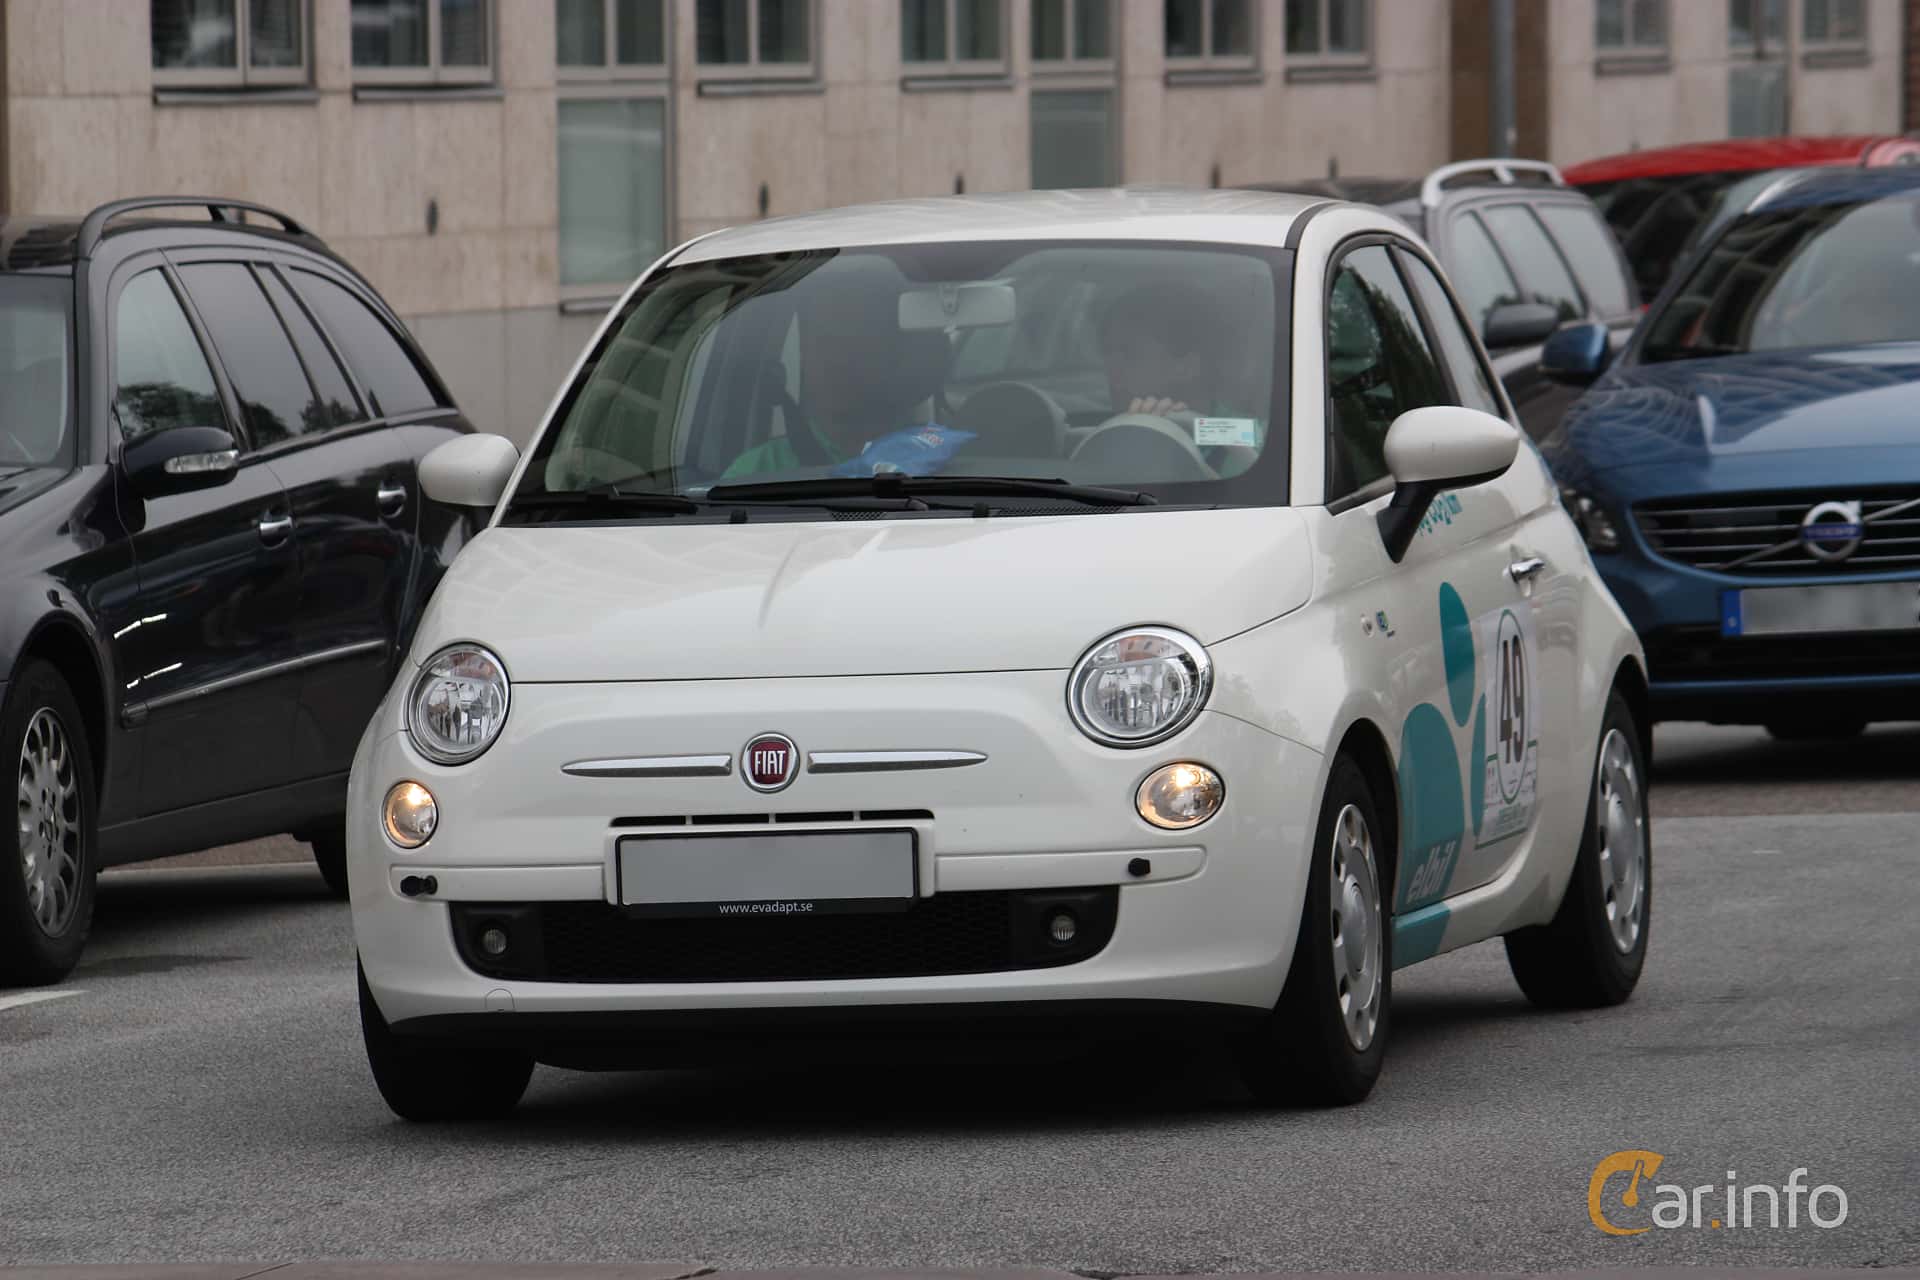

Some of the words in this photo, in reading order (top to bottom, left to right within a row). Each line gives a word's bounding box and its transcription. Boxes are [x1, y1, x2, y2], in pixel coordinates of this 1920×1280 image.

[1499, 634, 1526, 765] 49
[754, 750, 785, 776] FIAT
[719, 901, 813, 915] www.evadapt.se
